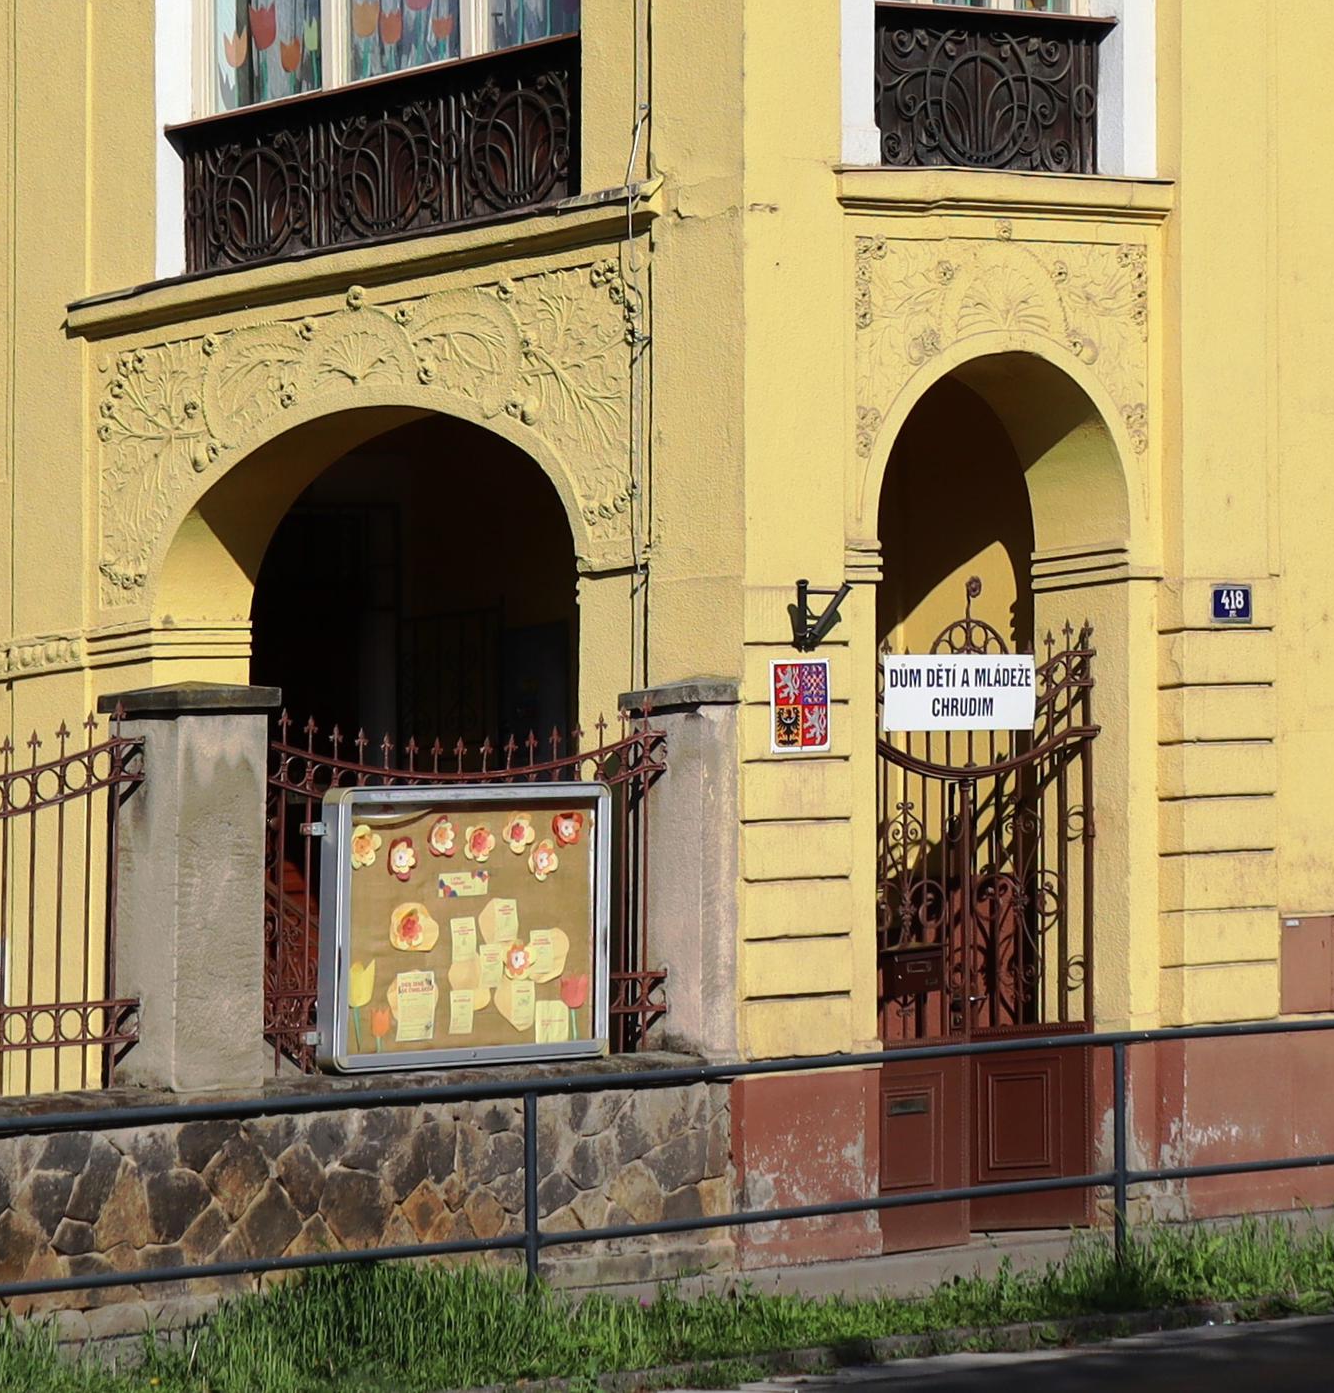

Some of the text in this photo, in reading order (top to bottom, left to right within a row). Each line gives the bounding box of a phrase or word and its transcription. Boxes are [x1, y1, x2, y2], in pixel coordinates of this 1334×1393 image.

[1221, 590, 1244, 609] 418
[889, 662, 1032, 688] DŮM DĚTÍ A MLÁDEŽE
[931, 697, 994, 717] CHRUDIM
